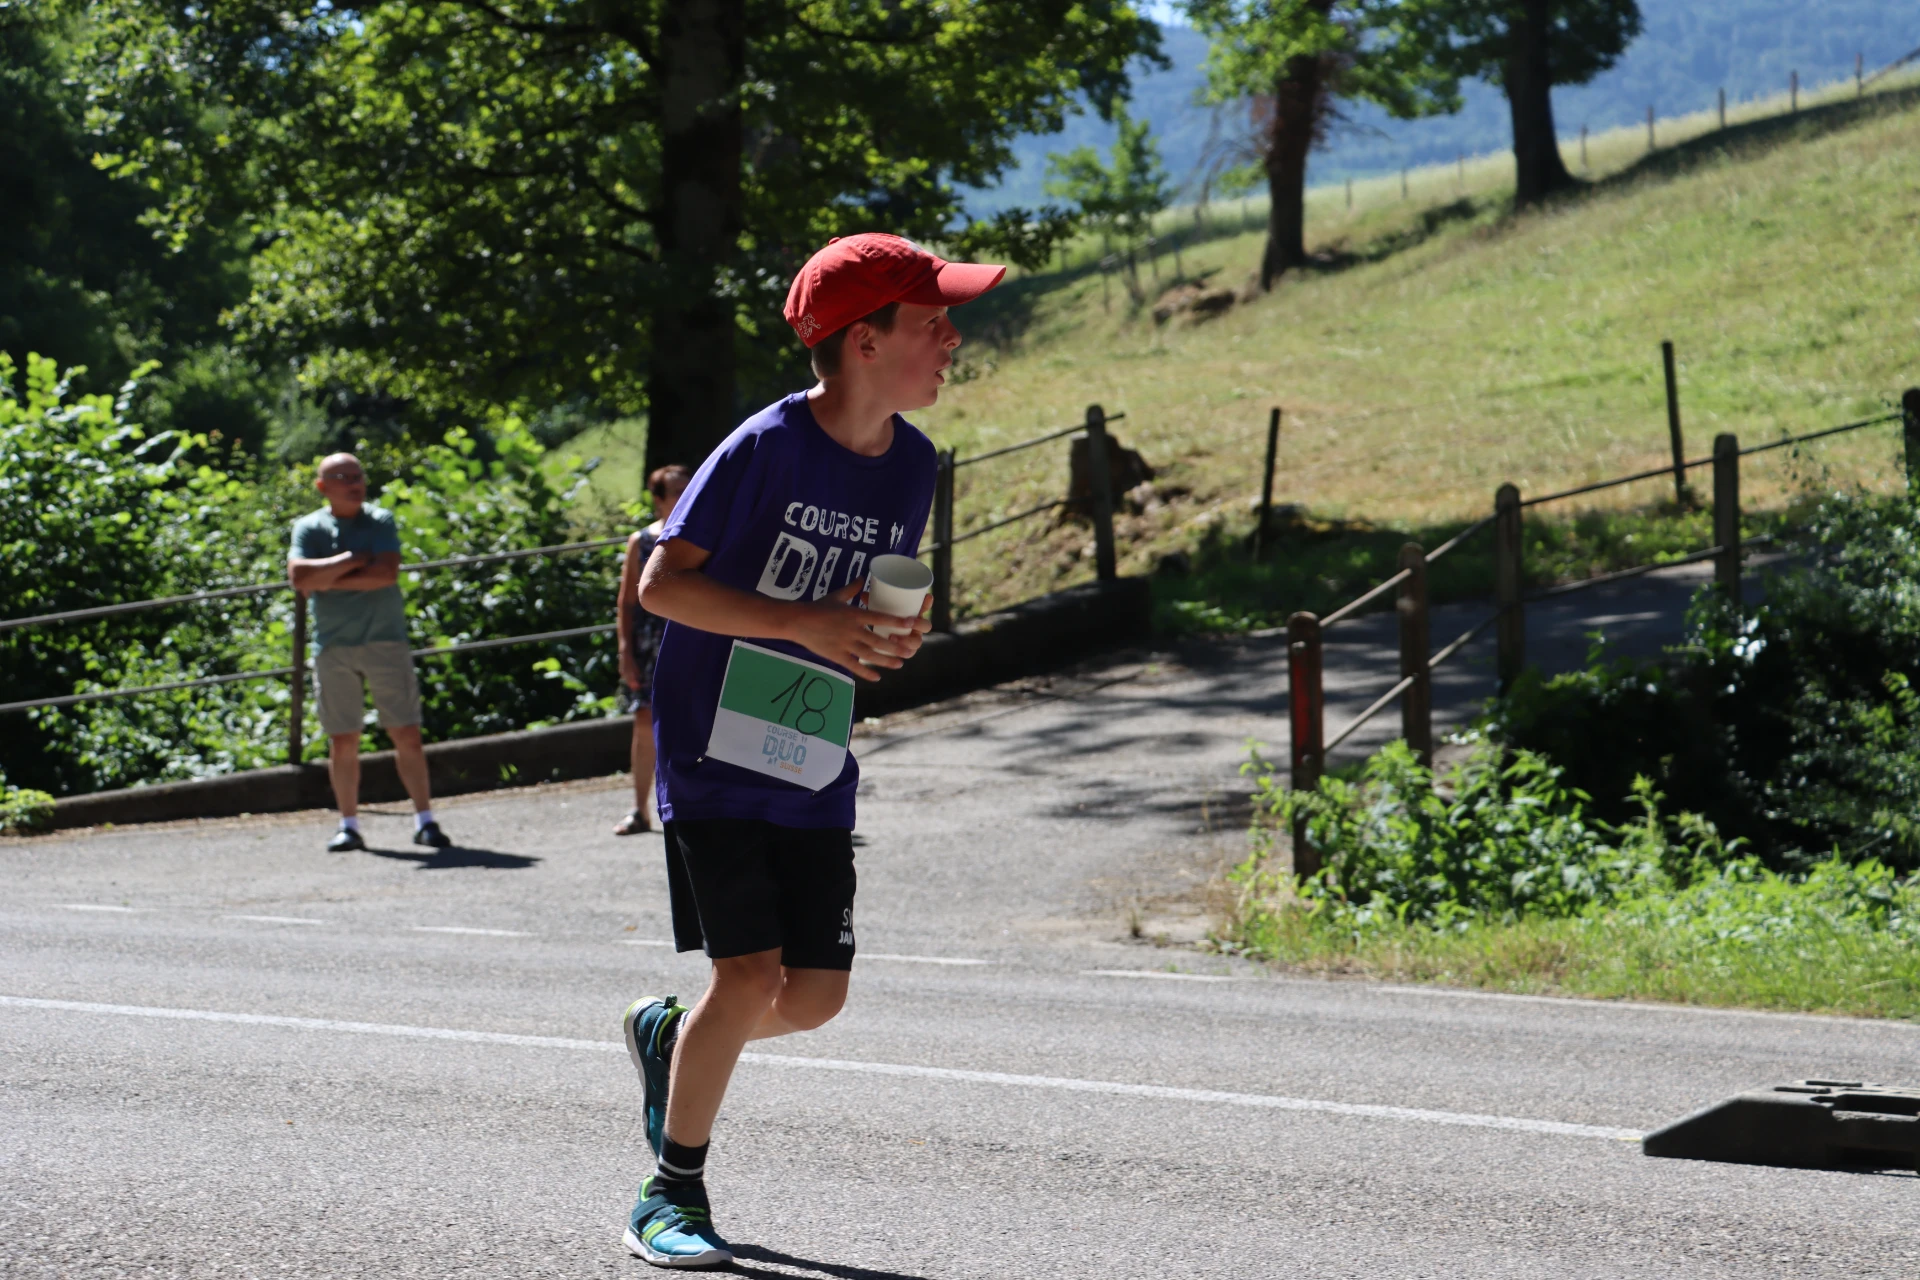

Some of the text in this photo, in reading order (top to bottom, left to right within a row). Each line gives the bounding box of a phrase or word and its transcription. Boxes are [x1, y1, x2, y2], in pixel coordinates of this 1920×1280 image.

[784, 502, 879, 544] COURSE
[756, 531, 871, 610] DU
[770, 670, 833, 735] 18
[762, 734, 807, 766] DUO
[767, 725, 798, 741] COURSE
